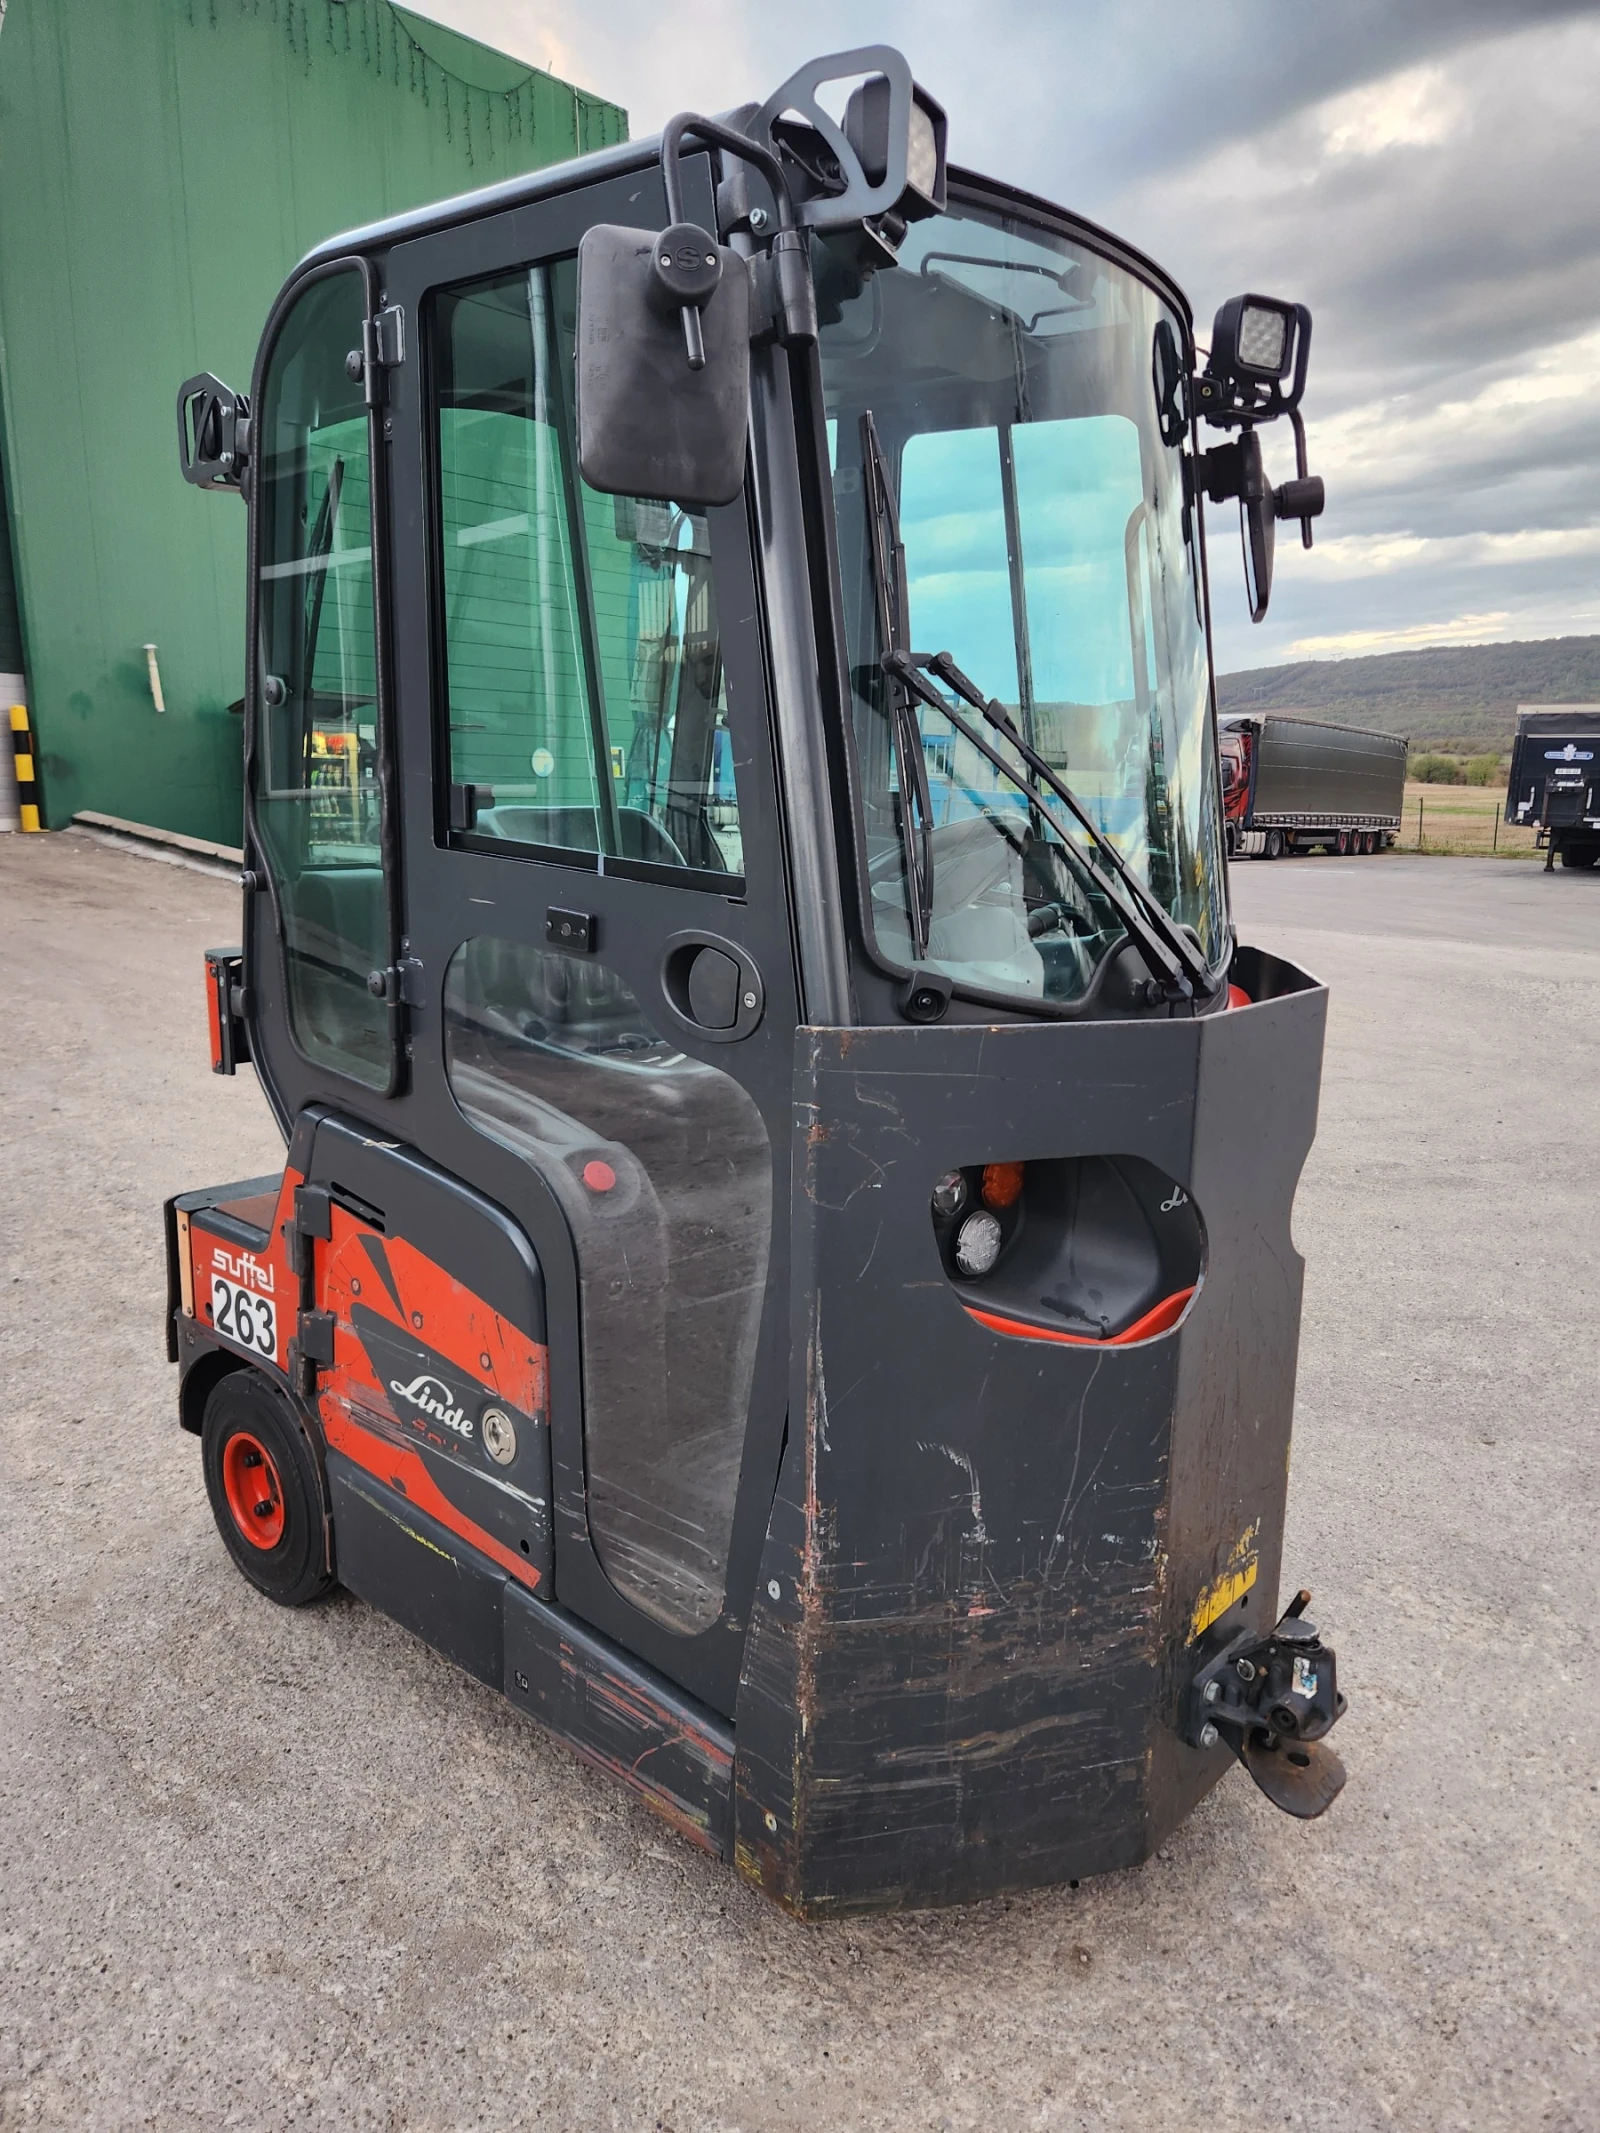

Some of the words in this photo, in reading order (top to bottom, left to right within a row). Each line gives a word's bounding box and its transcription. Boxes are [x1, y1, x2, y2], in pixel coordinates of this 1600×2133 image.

[211, 1247, 275, 1293] suffel
[213, 1279, 276, 1356] 263
[390, 1375, 474, 1439] Linde
